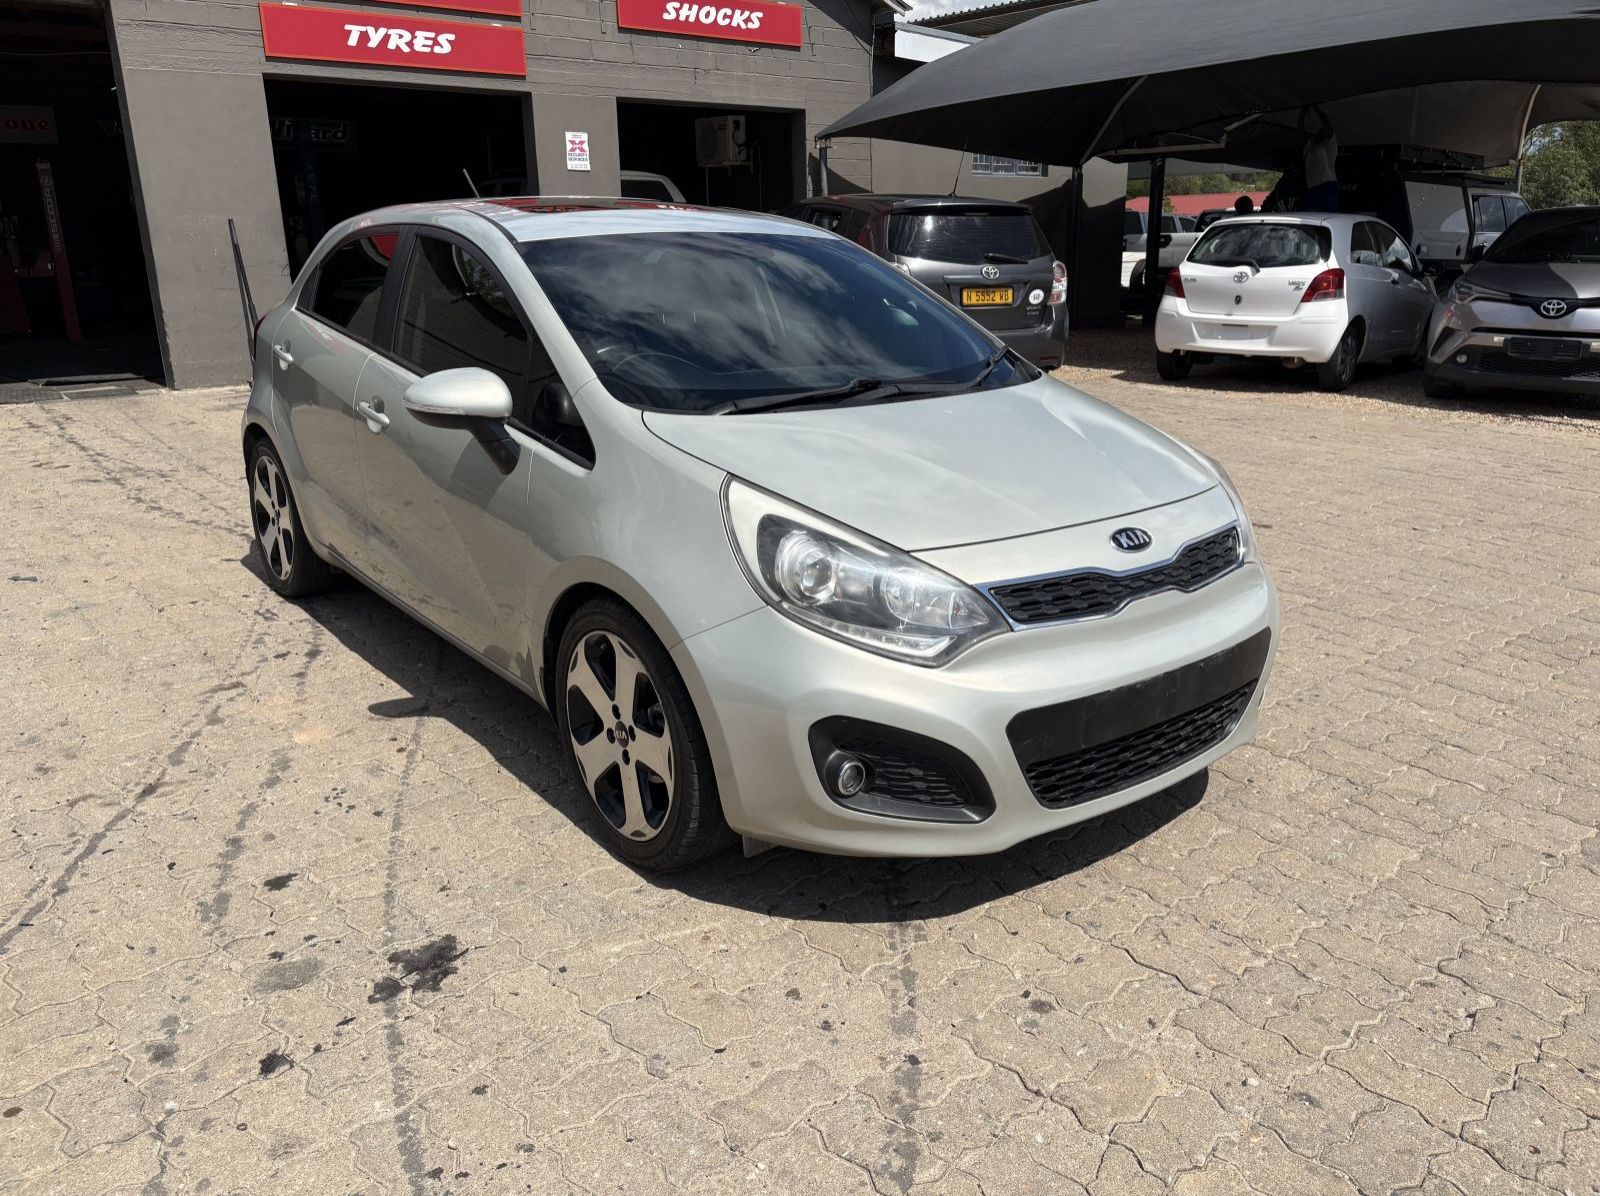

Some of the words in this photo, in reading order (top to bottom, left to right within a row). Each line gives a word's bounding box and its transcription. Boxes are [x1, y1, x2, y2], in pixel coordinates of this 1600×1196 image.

[662, 1, 764, 30] SHOCKS
[343, 24, 456, 54] TYRES
[0, 118, 49, 131] one
[966, 290, 972, 302] N
[1114, 529, 1150, 548] KIA
[615, 729, 628, 740] KIA
